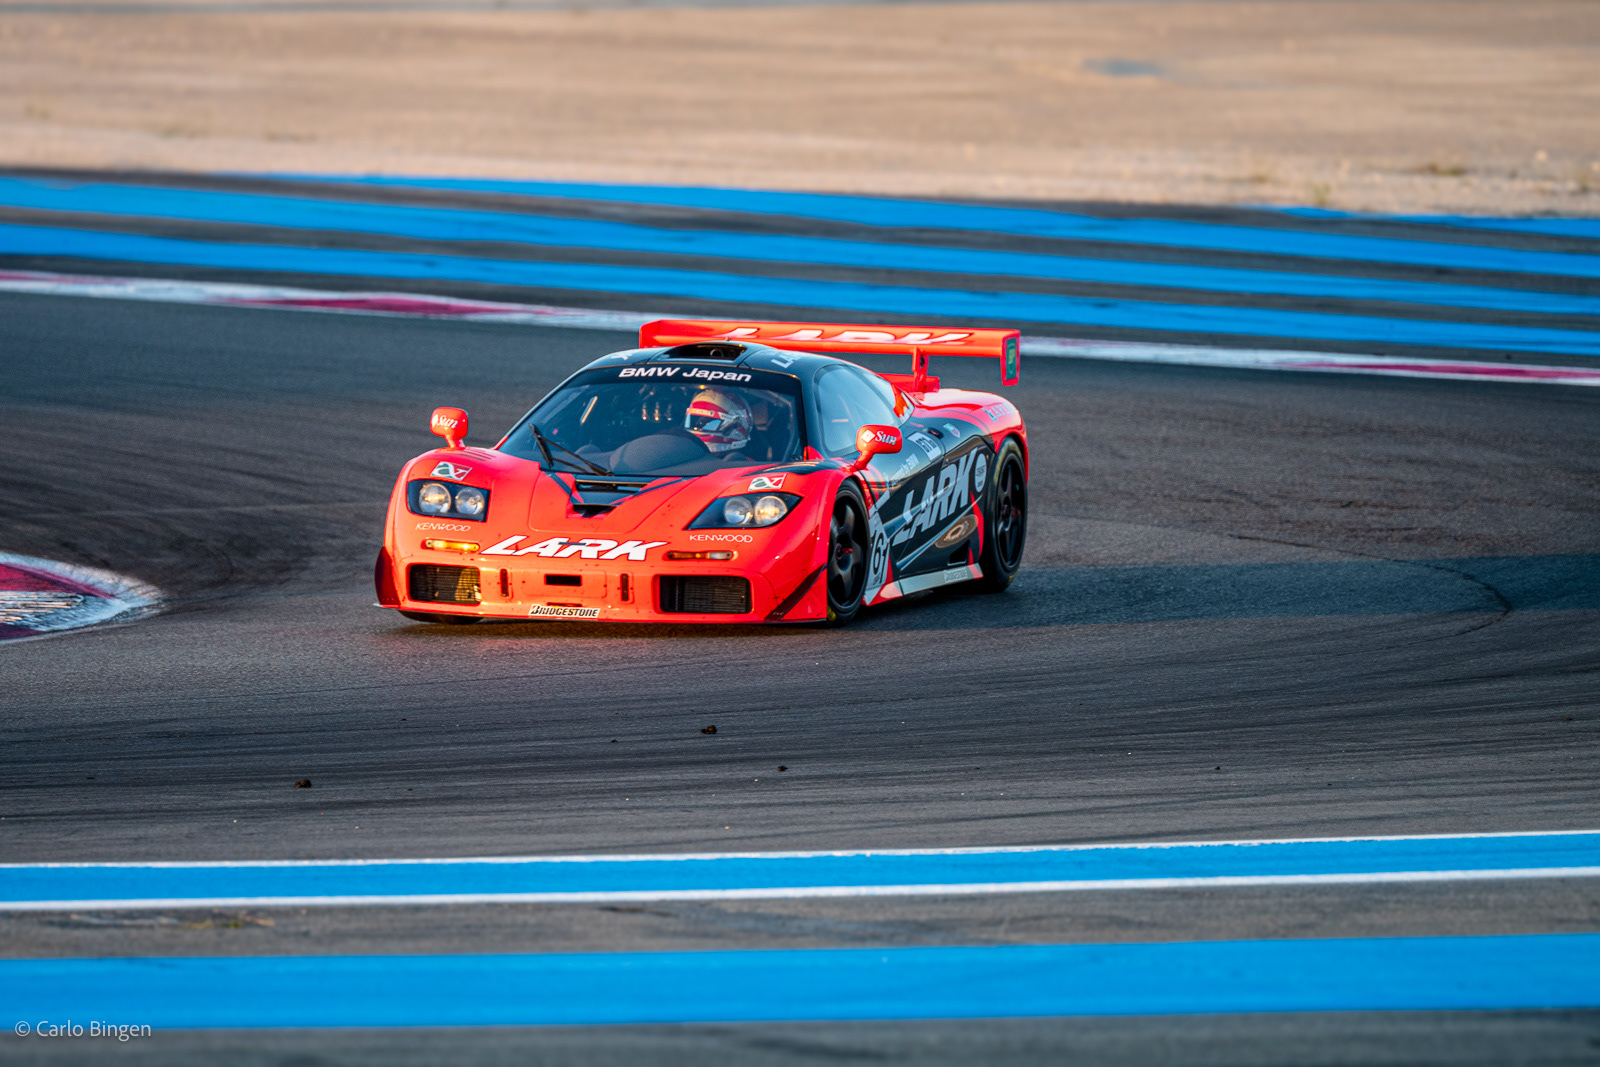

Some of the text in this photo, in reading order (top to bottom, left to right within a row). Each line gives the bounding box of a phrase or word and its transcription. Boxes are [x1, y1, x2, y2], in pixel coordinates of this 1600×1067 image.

[618, 366, 752, 382] BMW Japan
[437, 415, 458, 429] Sun
[875, 431, 897, 446] Sun
[891, 447, 978, 547] LARK
[415, 522, 471, 532] KENWOOD
[689, 534, 753, 543] KENWOOD
[480, 535, 670, 561] LARK
[530, 605, 599, 617] BRIDGESTONE
